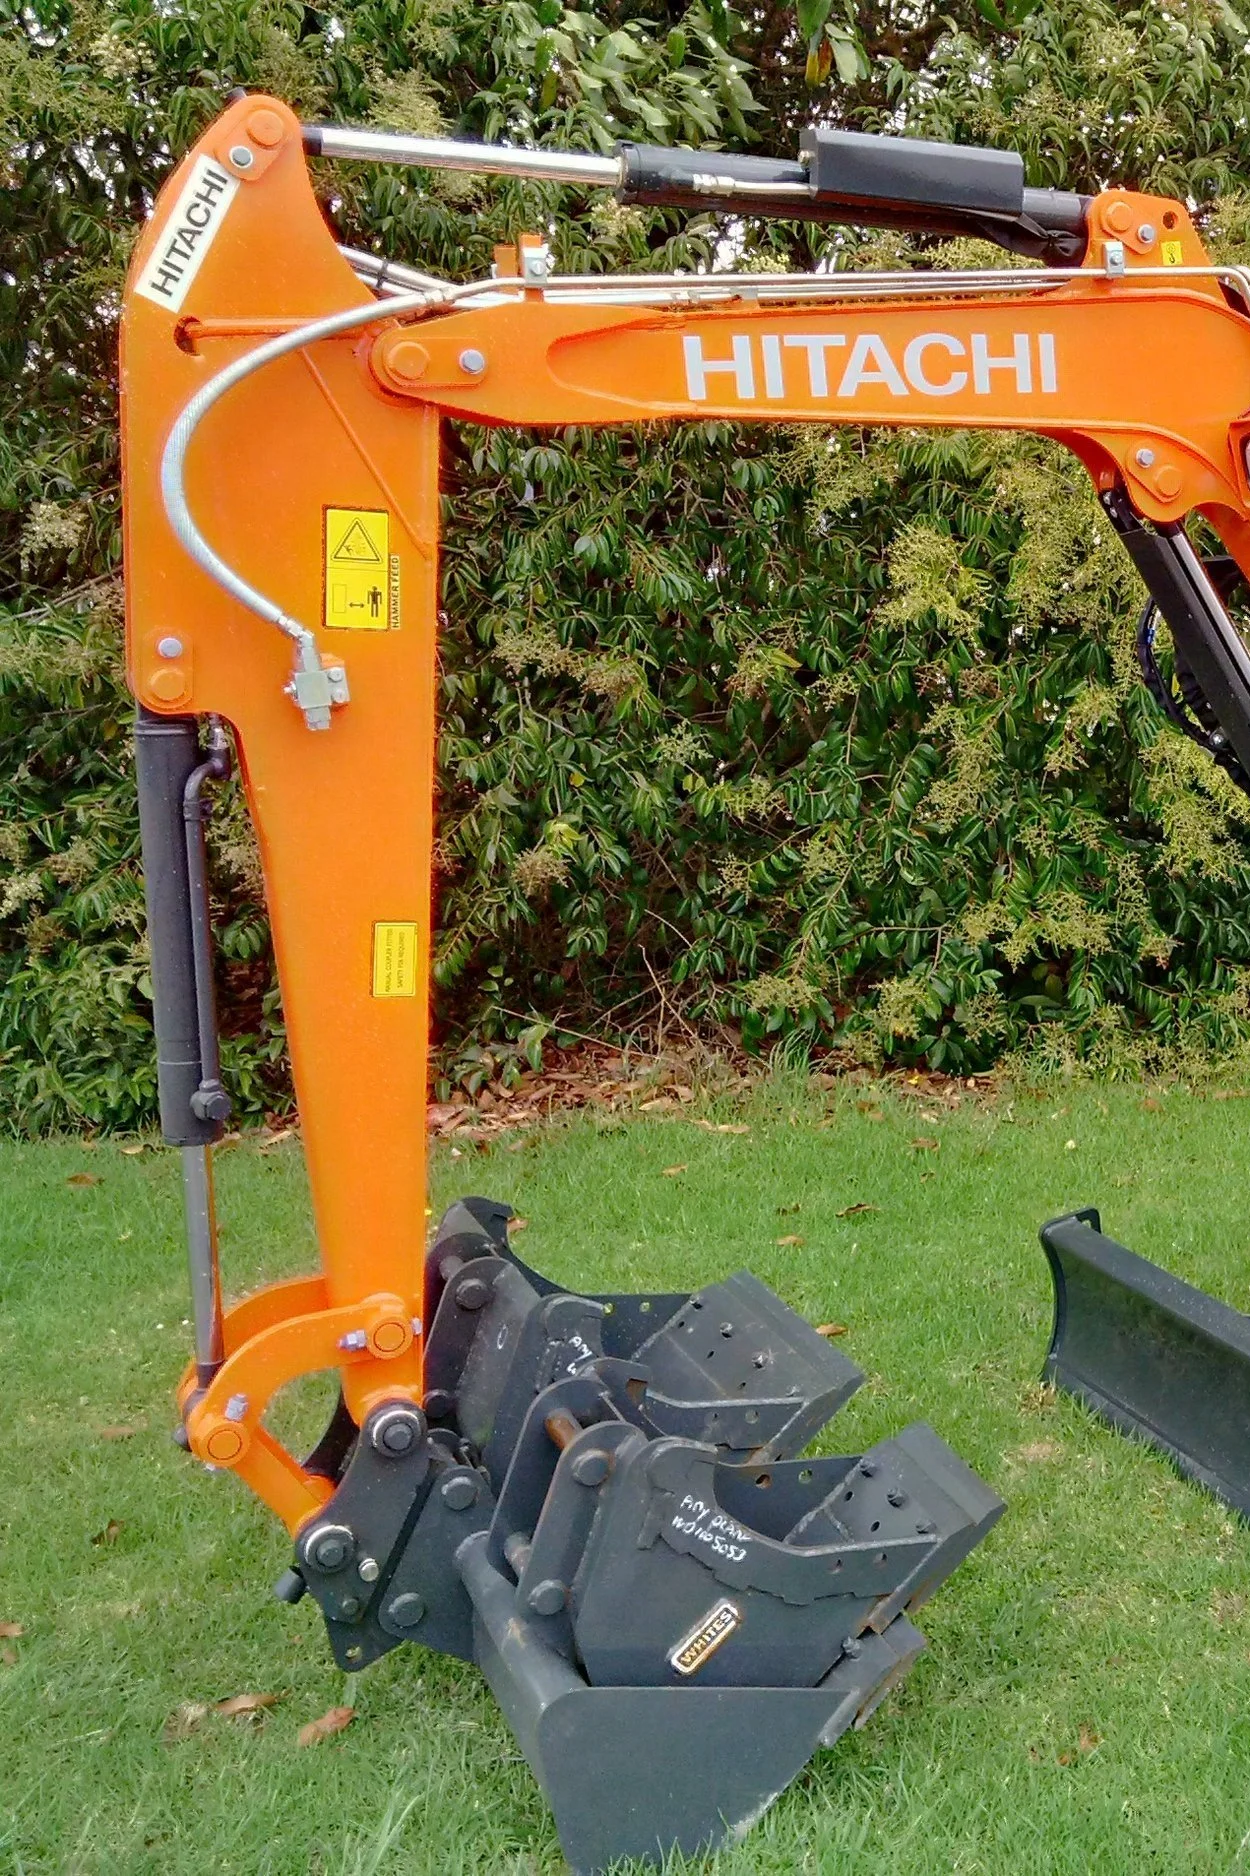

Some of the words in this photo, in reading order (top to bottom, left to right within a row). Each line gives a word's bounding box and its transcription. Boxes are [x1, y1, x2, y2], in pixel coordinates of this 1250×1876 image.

[150, 168, 228, 297] HITACHI
[682, 332, 1058, 400] HITACHI
[391, 557, 399, 582] FEED
[391, 585, 399, 628] HAMMER
[680, 1611, 733, 1663] WHITES
